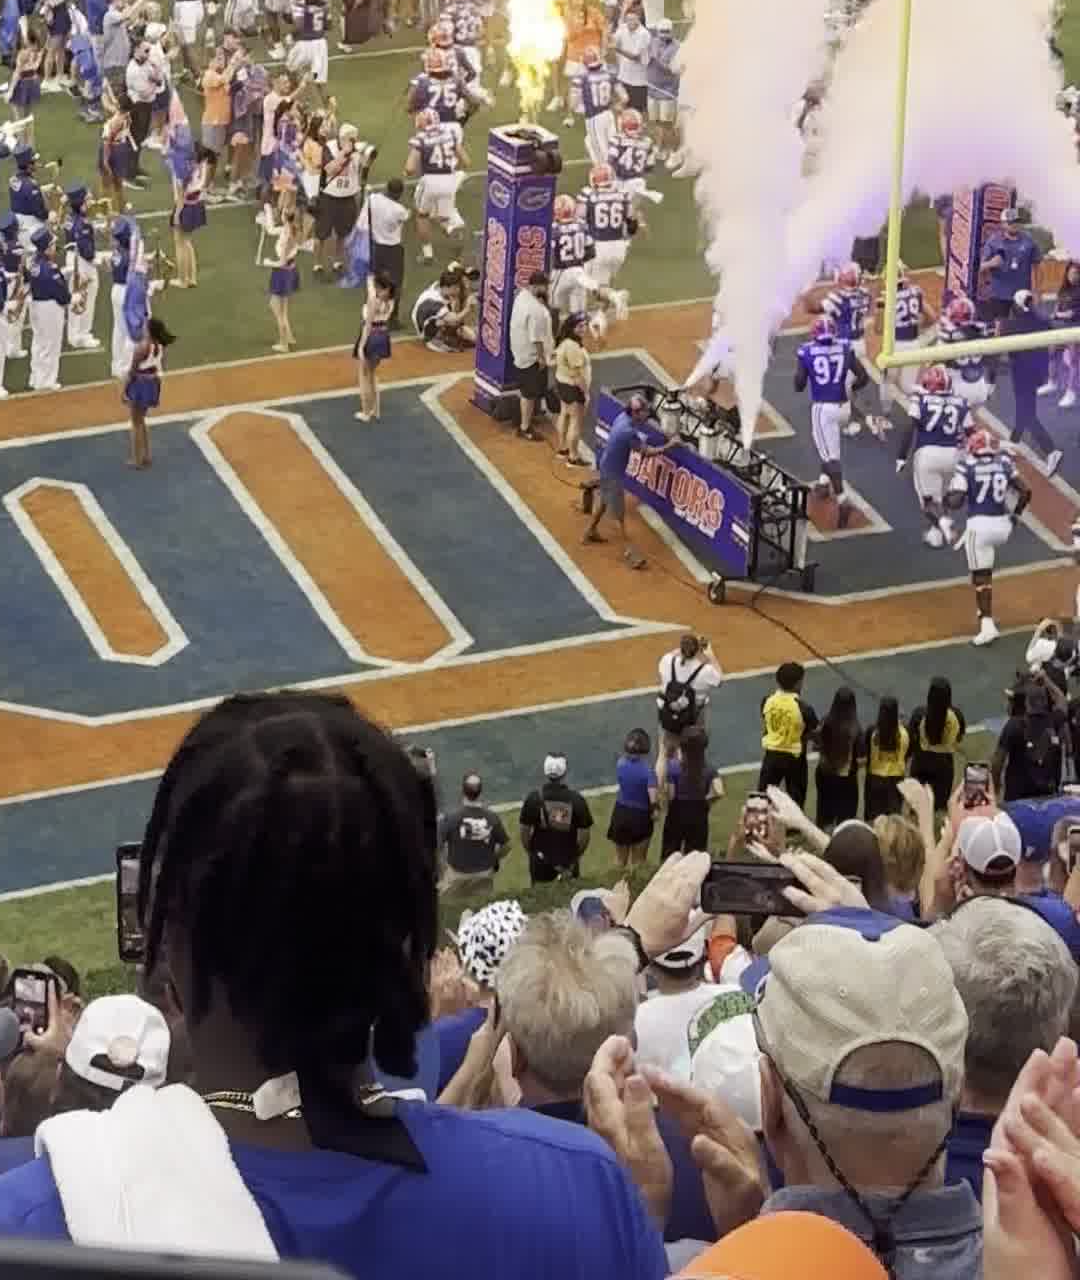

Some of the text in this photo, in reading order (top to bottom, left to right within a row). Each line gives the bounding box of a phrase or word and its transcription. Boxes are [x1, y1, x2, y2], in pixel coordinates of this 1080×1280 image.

[594, 202, 624, 229] 66
[559, 231, 585, 261] 20
[813, 353, 845, 385] 97
[925, 403, 958, 435] 73
[975, 473, 1007, 504] 78
